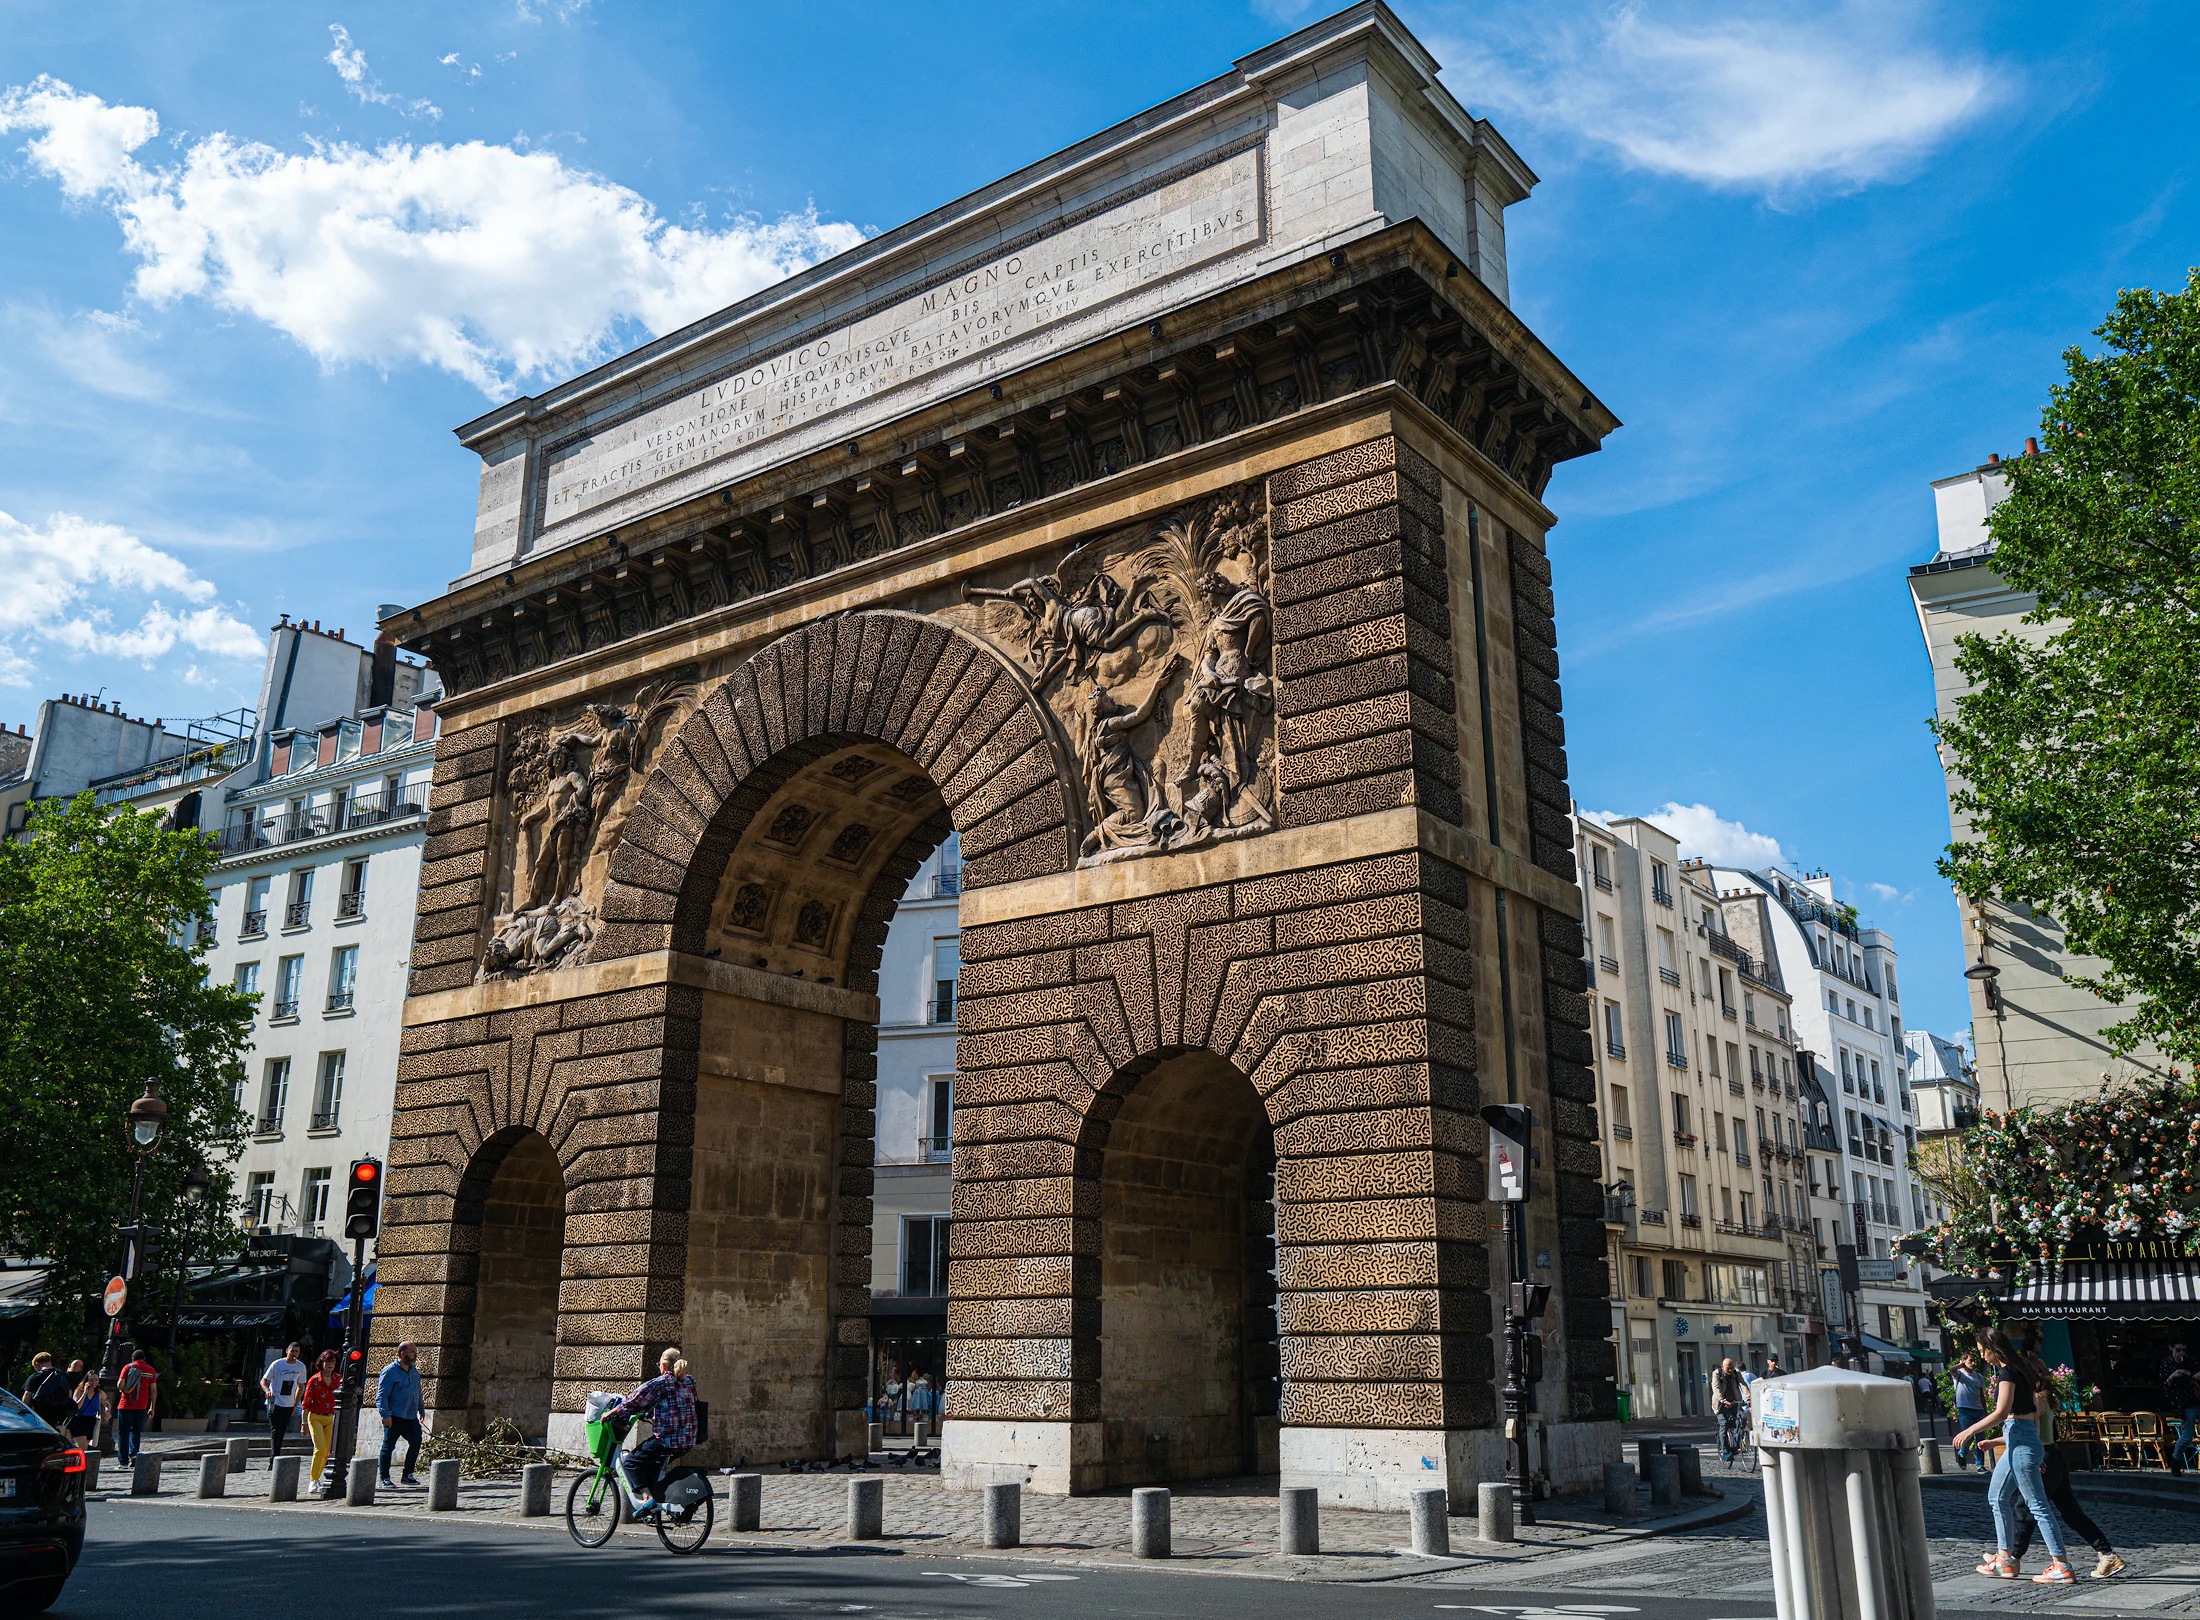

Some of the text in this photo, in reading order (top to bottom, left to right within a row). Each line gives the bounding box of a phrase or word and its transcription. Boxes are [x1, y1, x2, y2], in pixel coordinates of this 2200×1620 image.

[701, 257, 1022, 409] LVDOVICO MAGNO
[554, 489, 570, 505] ET
[581, 459, 642, 494] FRACTIS
[655, 408, 766, 462] GERMANORVM
[911, 279, 1076, 358] BATAVORVMQVE
[1095, 209, 1244, 281] EXERCITIBVS
[646, 250, 1099, 449] VESONTIONE SEQVANISQVE BIS CAPTIS
[702, 445, 717, 460] ET
[1854, 1204, 1866, 1254] HOTEL
[260, 1249, 278, 1258] DROITE
[209, 1315, 225, 1325] du
[2044, 1306, 2107, 1314] RESTAURANT
